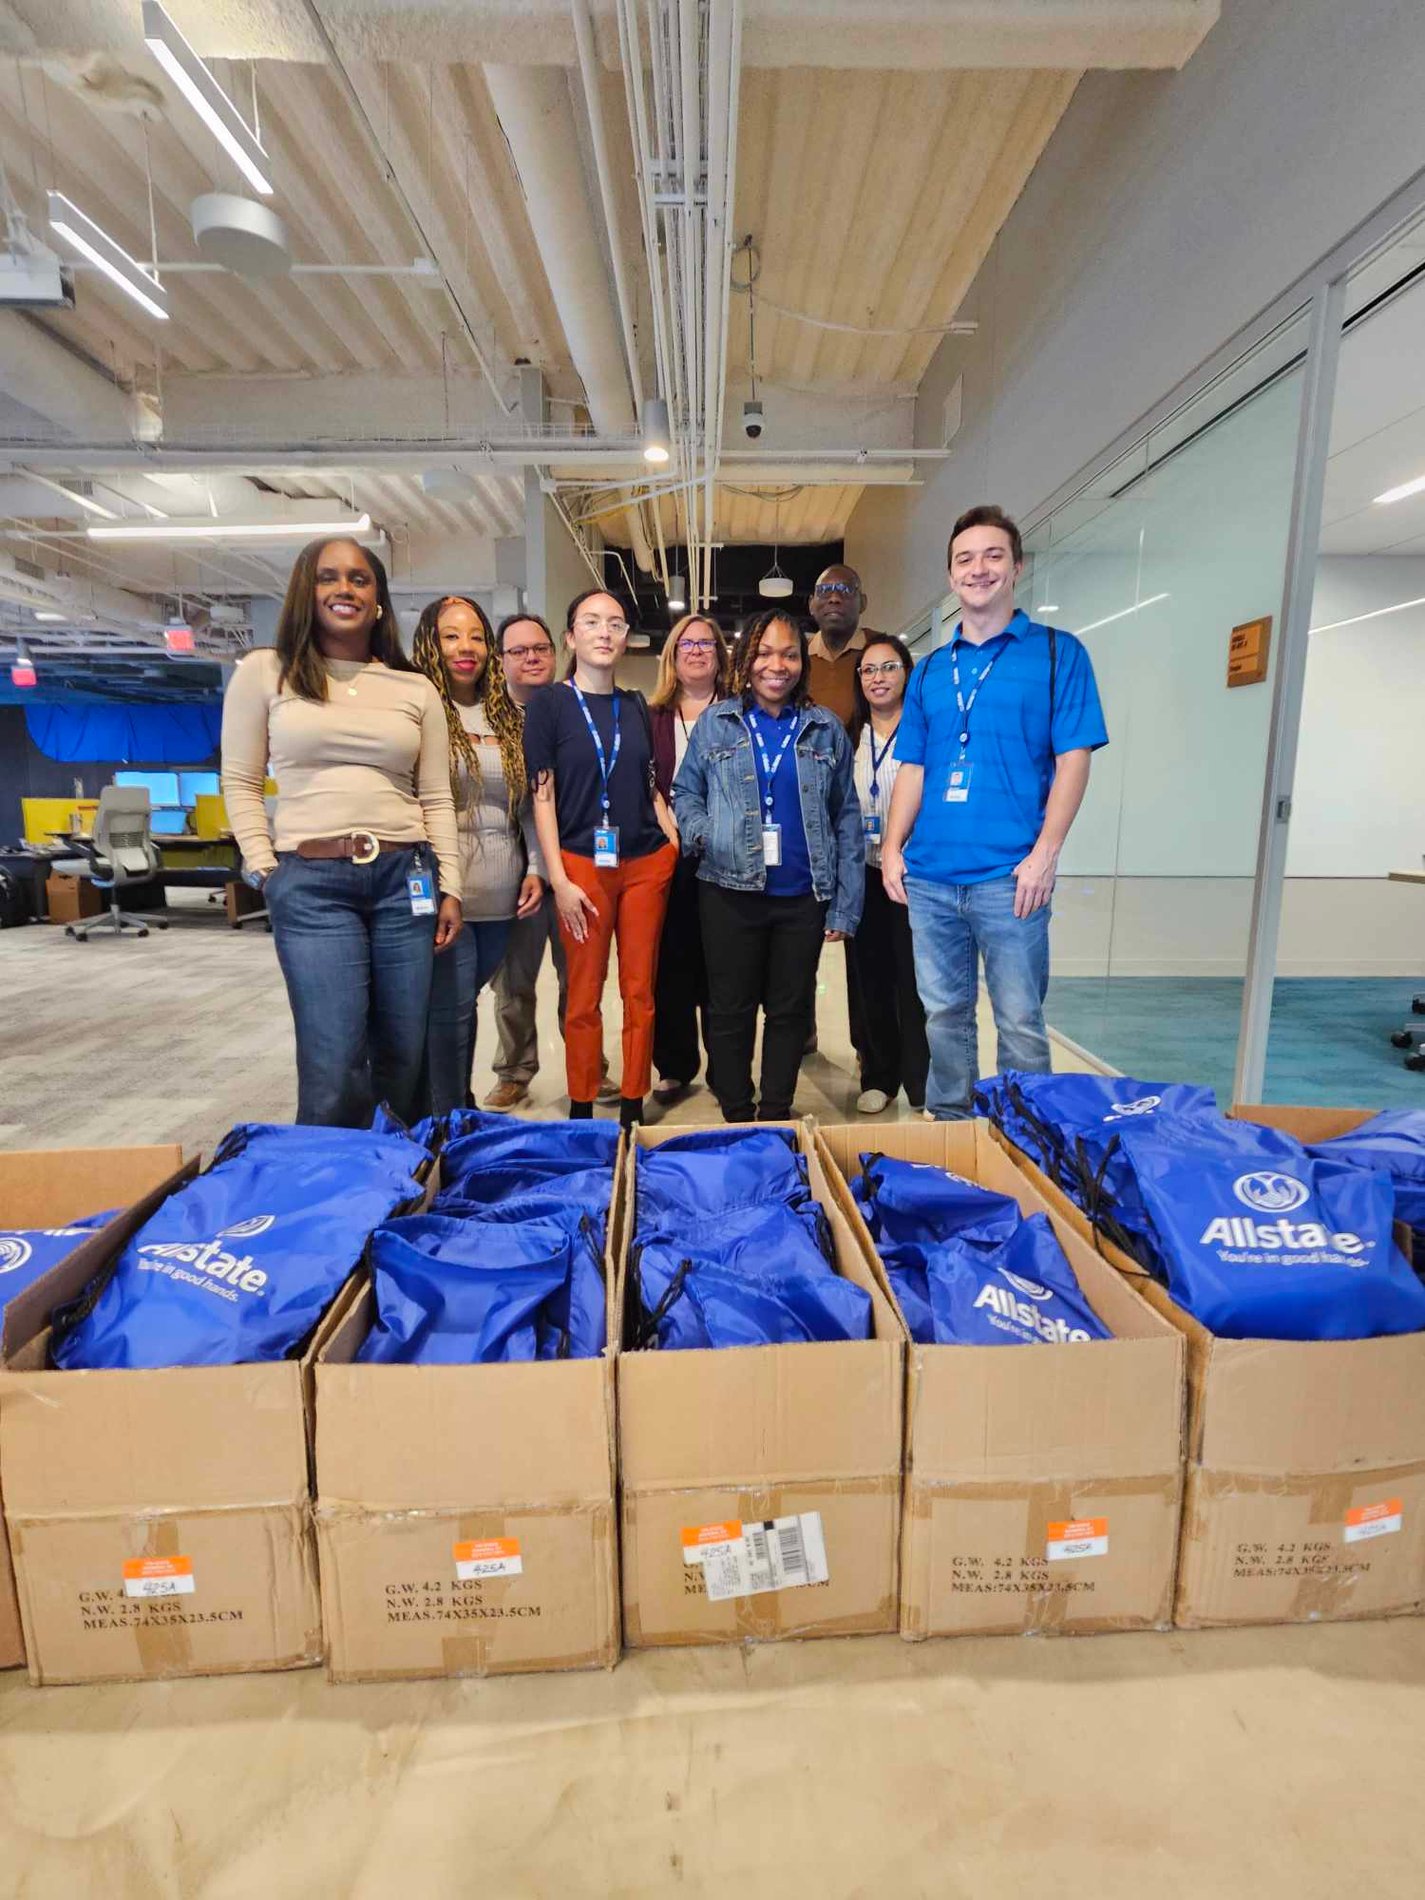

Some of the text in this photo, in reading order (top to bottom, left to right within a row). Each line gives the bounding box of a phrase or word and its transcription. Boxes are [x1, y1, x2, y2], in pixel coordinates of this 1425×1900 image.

[1200, 1217, 1365, 1254] Allstae
[137, 1240, 268, 1293] Allstate
[171, 1269, 205, 1286] good
[1236, 1541, 1331, 1553] G.W. 4.2 KGS
[952, 1557, 1049, 1567] G.W. 4.2 KGS
[1234, 1554, 1330, 1565] N.W. 2.8 KGS
[951, 1570, 1050, 1580] N.W. 2.8 KGS
[385, 1580, 483, 1595] G.W. 4.2 KGS
[79, 1591, 113, 1602] G.W.
[386, 1595, 484, 1609] N.W. 2.8 KGS
[81, 1601, 182, 1616] N.W. 2.8 KGS
